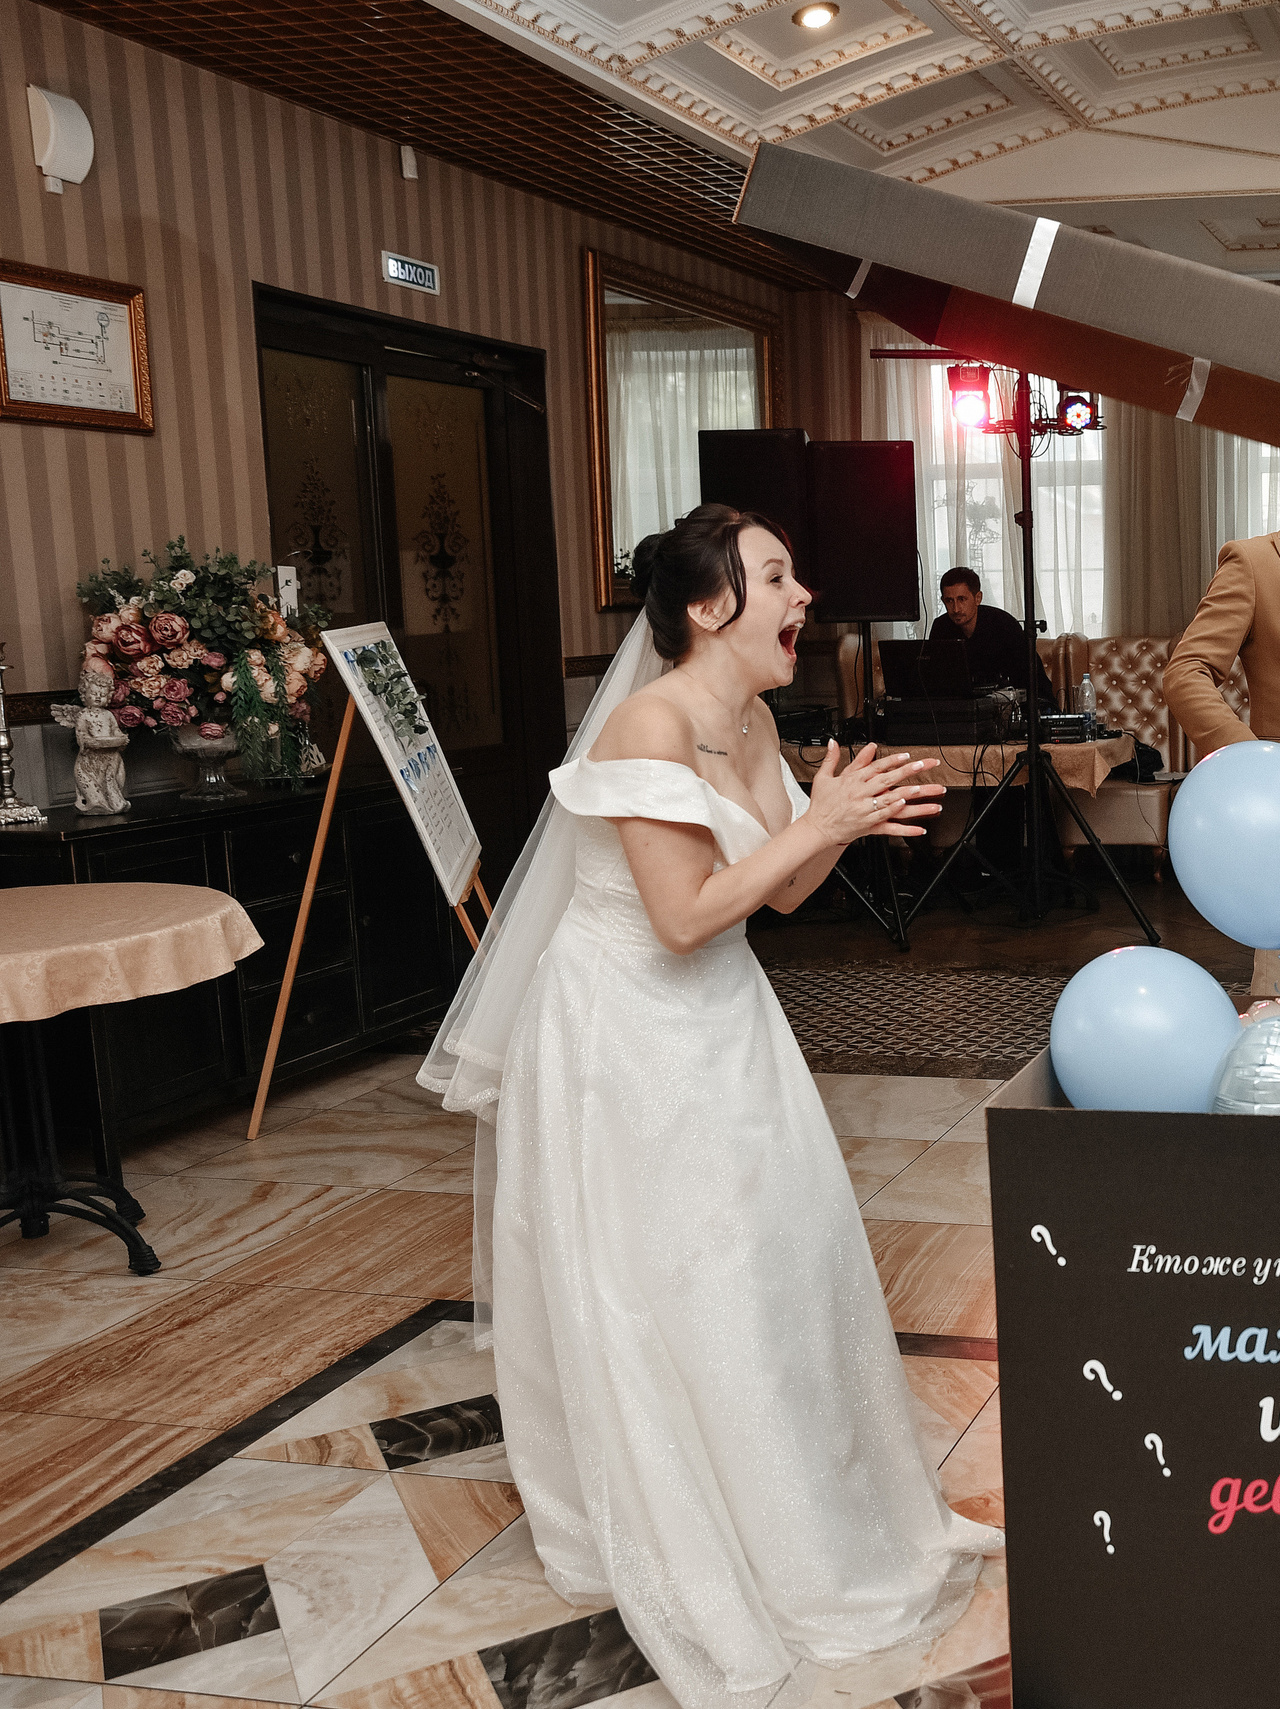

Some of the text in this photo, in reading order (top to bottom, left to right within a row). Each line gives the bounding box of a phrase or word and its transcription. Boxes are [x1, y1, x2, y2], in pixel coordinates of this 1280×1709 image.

[388, 258, 434, 289] ВЫХОД
[1030, 1224, 1067, 1267] ?
[1082, 1359, 1123, 1401] ?
[1143, 1432, 1172, 1478] ?
[1093, 1510, 1115, 1555] ?
